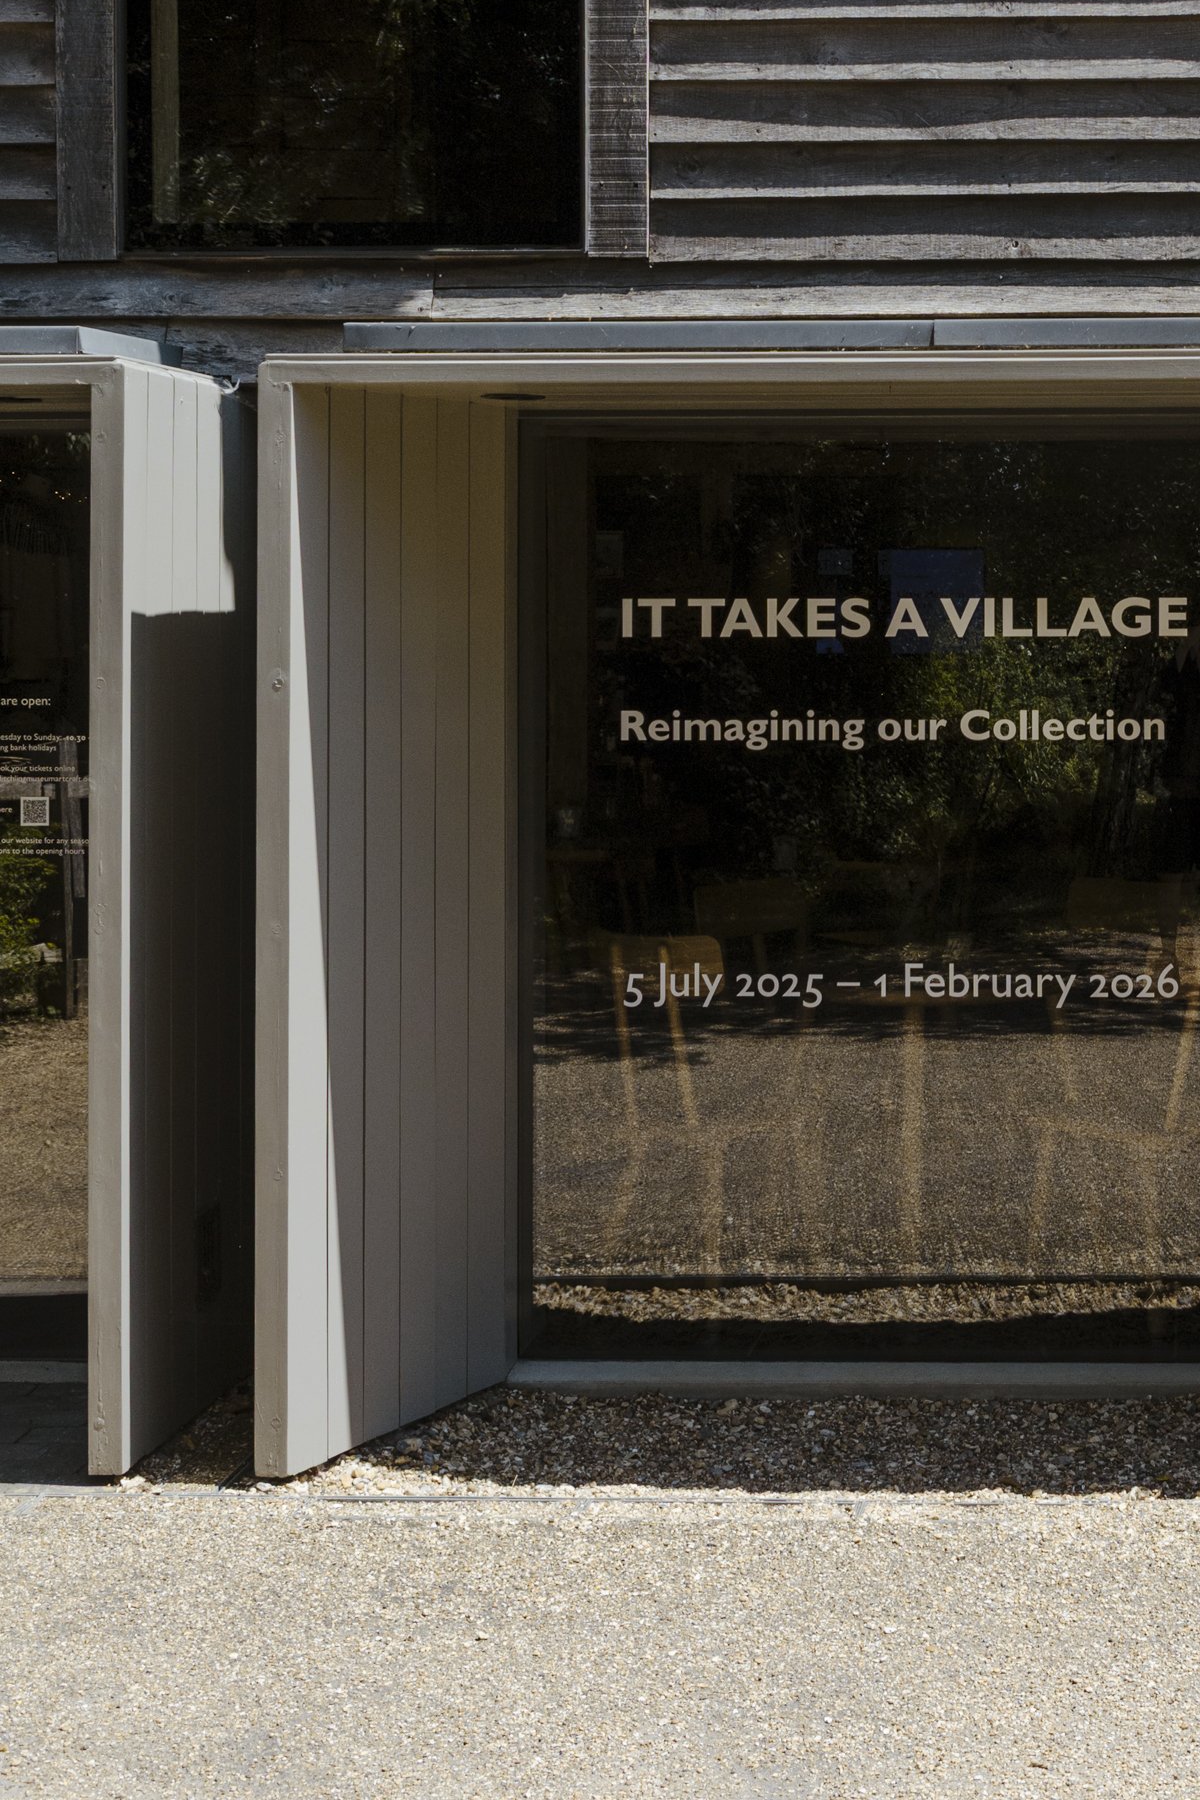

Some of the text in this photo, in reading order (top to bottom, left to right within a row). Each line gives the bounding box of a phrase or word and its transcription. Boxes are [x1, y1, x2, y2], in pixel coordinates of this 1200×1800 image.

[621, 596, 1188, 638] IT TAKES A VILLAGE
[20, 698, 51, 709] open:
[619, 708, 1166, 751] Reimagining our Collection
[0, 733, 21, 743] esday
[65, 735, 86, 743] 10.30
[28, 744, 57, 753] holidays
[56, 838, 69, 846] any
[22, 847, 34, 855] the
[35, 847, 63, 857] opening
[64, 847, 85, 855] hours
[623, 973, 645, 1008] 5
[653, 962, 723, 1008] July
[735, 973, 824, 1008] 2025
[873, 973, 888, 998] 1
[904, 963, 1077, 1009] February
[1089, 963, 1180, 998] 2026
